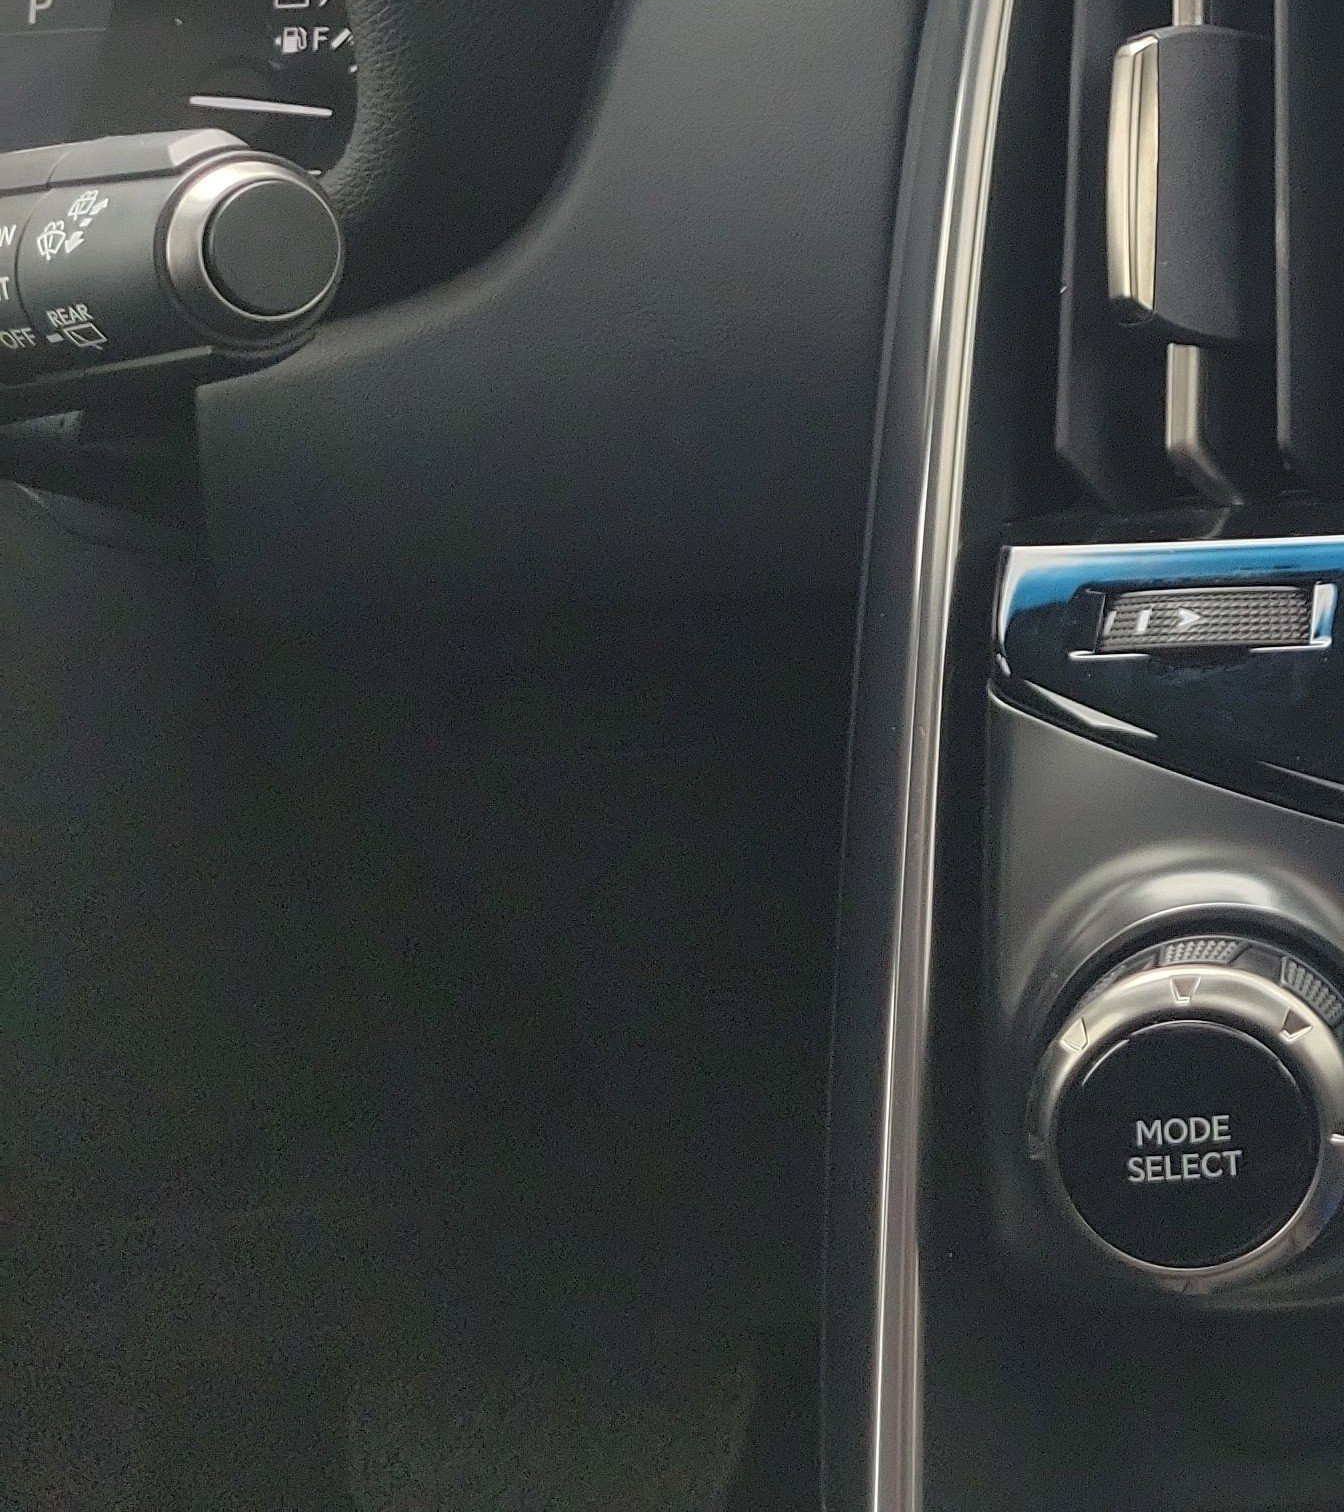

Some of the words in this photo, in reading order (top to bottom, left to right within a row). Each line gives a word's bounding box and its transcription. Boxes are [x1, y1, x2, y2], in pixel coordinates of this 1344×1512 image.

[47, 303, 93, 327] REAR
[0, 327, 36, 349] OFF
[1136, 1115, 1231, 1146] MODE
[1127, 1151, 1242, 1183] SELECT
